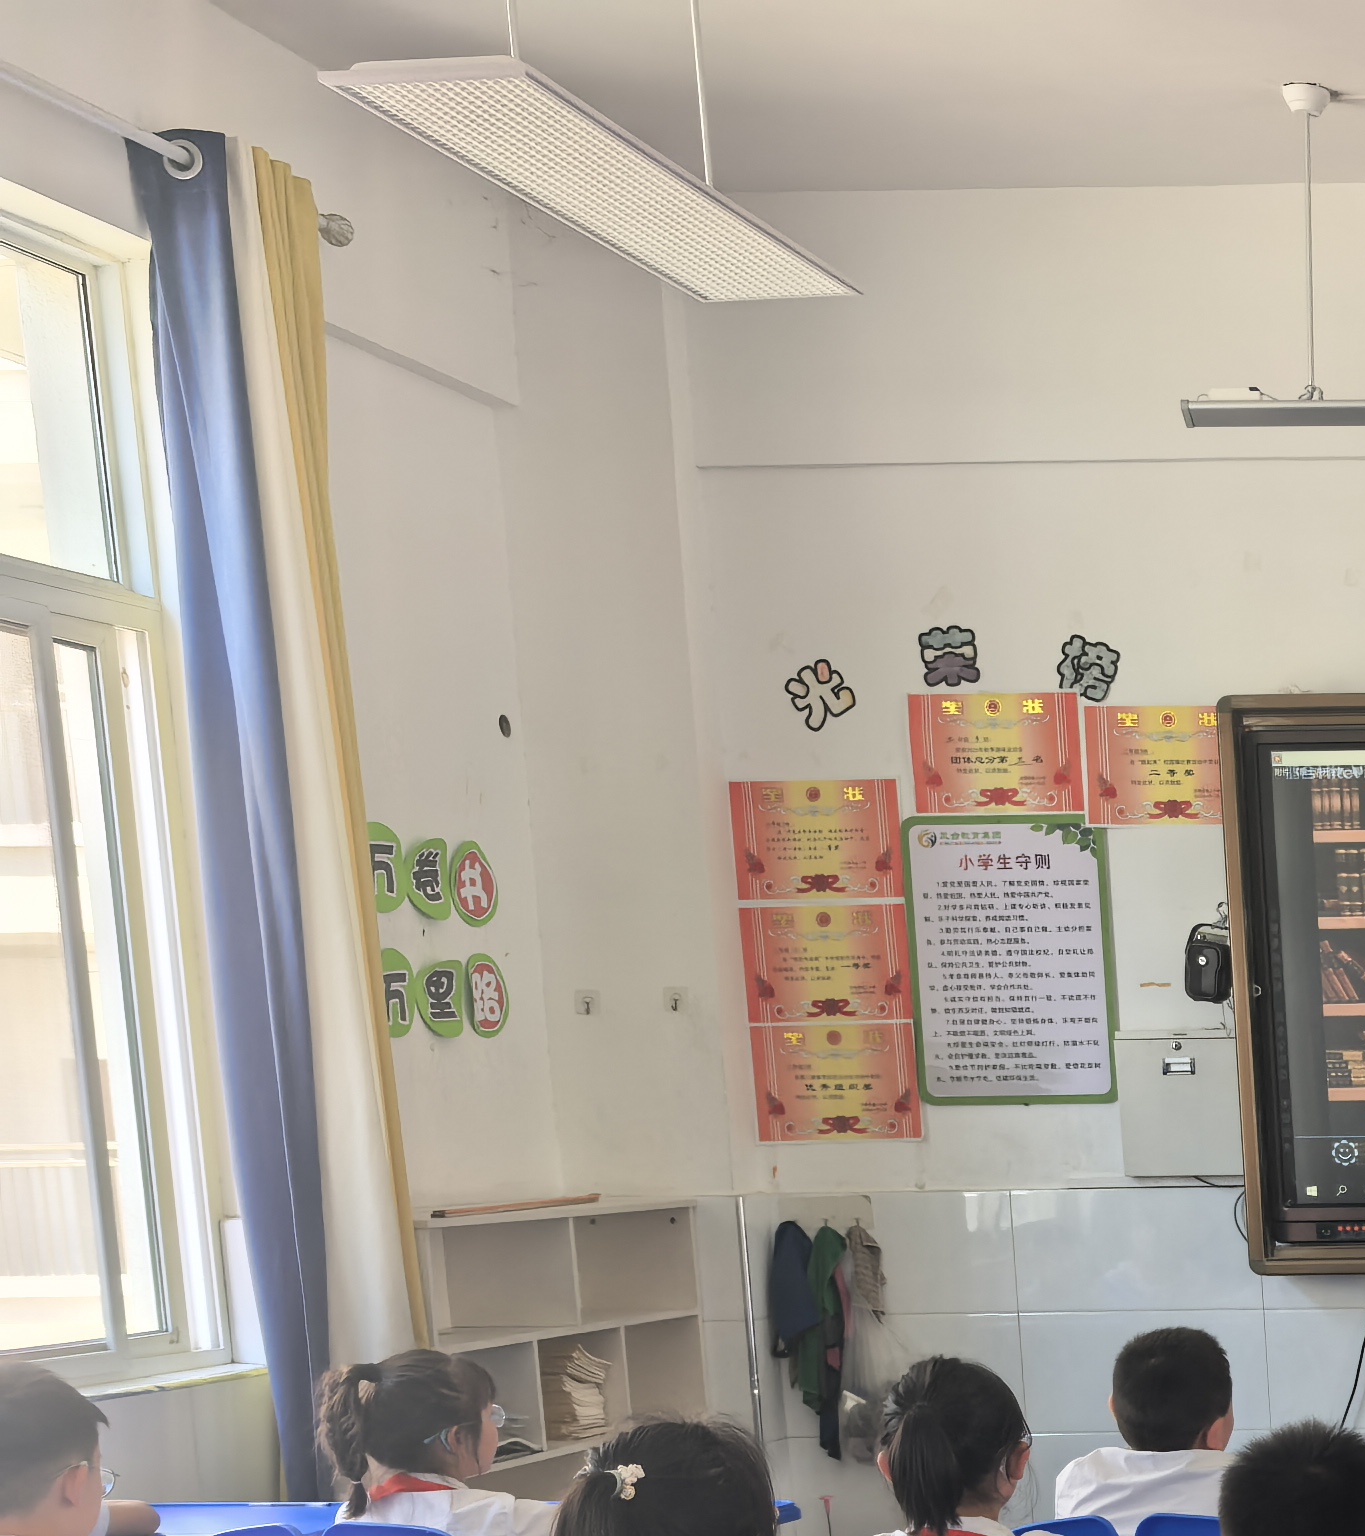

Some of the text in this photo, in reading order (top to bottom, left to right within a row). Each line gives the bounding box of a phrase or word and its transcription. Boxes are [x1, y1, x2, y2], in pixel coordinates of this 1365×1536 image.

[785, 625, 1120, 732] 光荣榜
[369, 841, 488, 911] 万卷书
[959, 853, 1051, 871] 小学生守则
[382, 969, 502, 1024] 万里路
